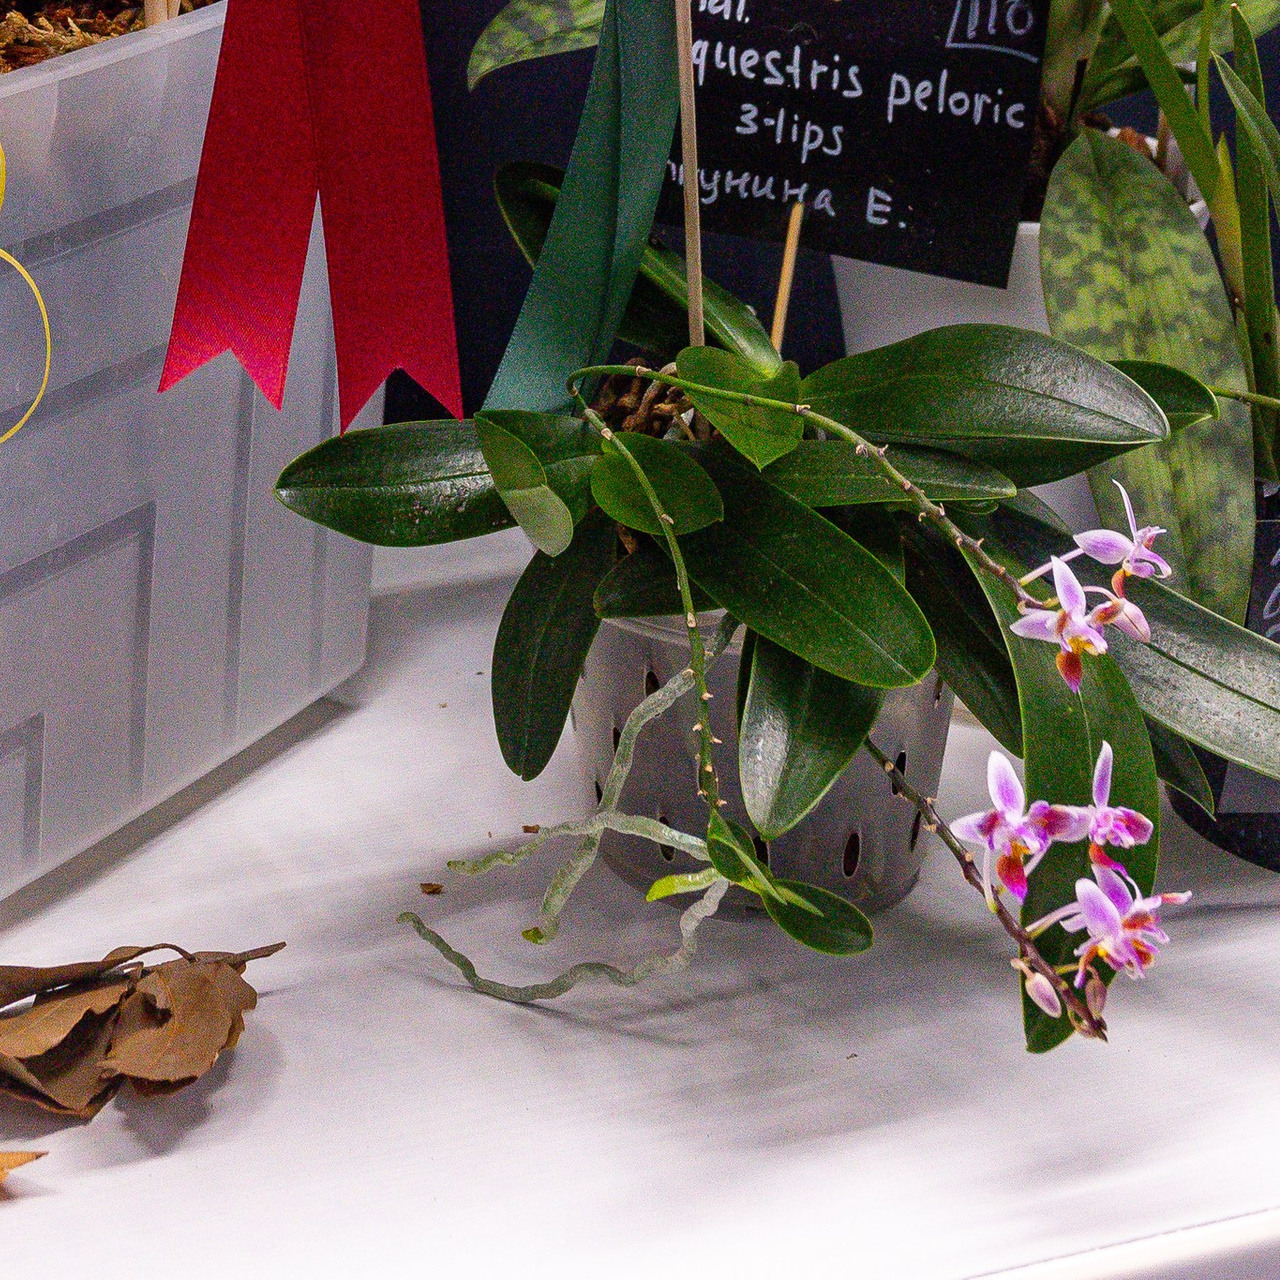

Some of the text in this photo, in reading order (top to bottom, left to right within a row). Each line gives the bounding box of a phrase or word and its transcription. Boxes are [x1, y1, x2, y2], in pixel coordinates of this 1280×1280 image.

[692, 39, 1025, 129] questris peloric
[735, 102, 844, 165] 3-lips
